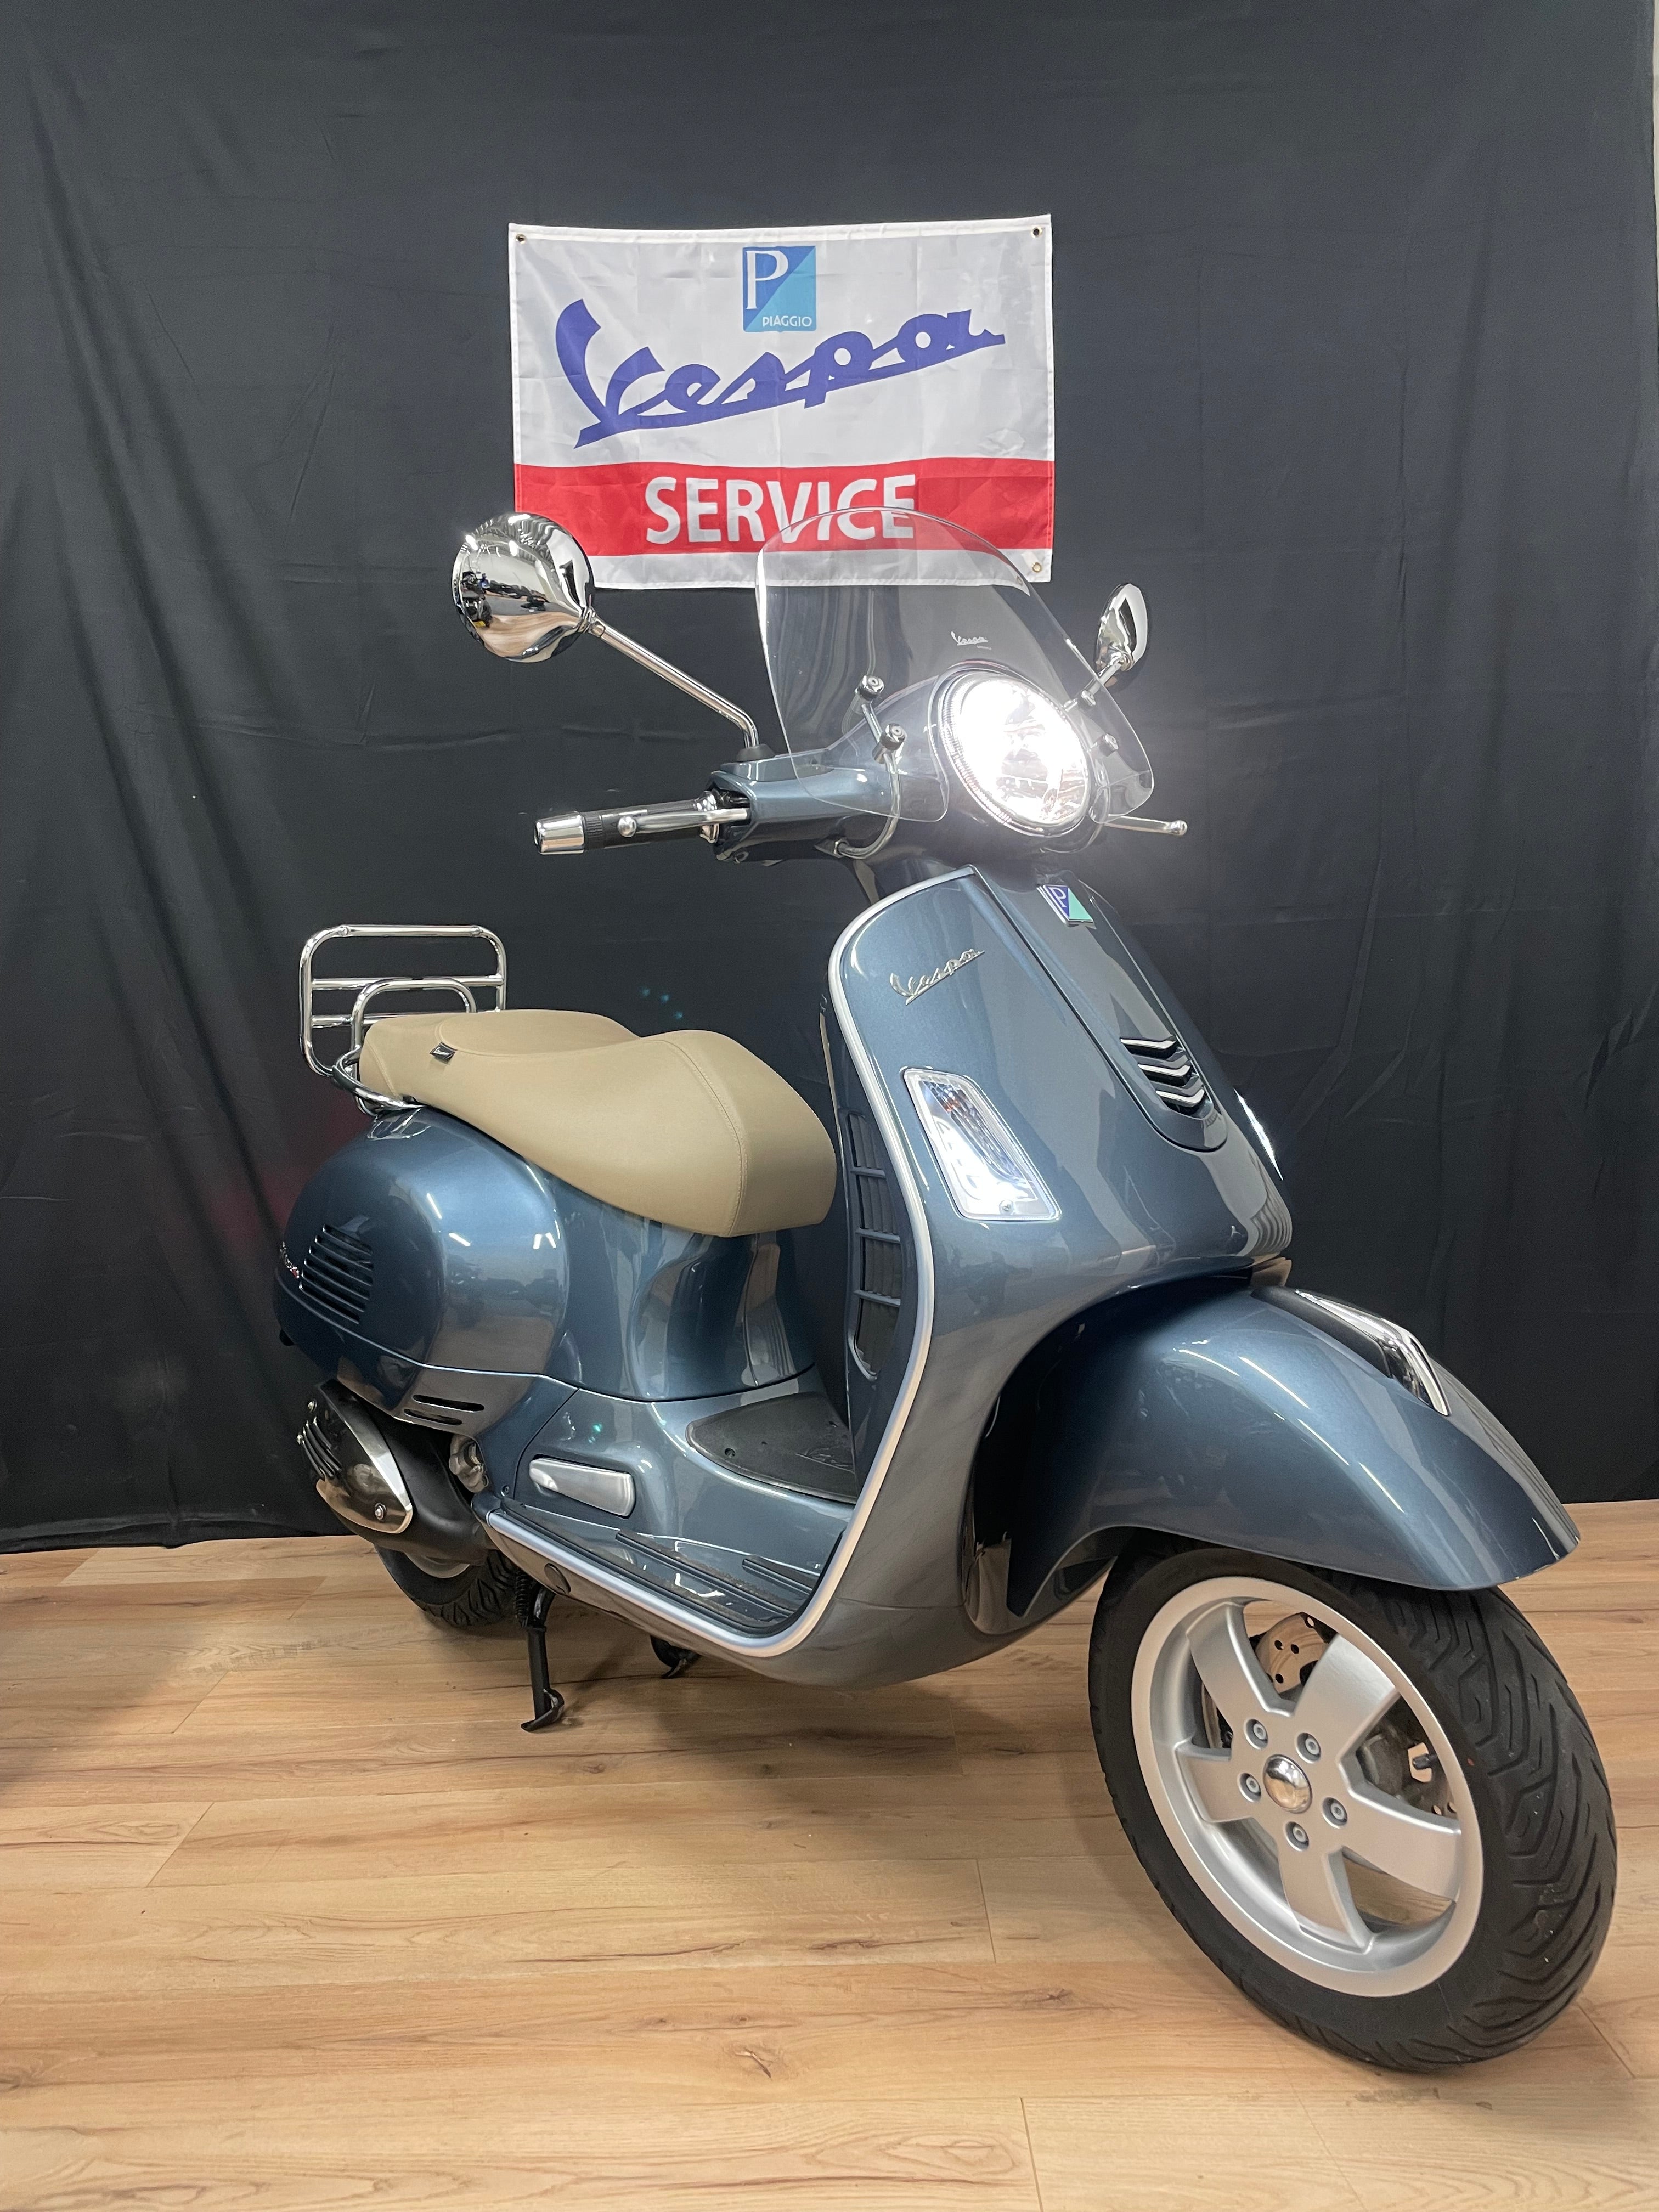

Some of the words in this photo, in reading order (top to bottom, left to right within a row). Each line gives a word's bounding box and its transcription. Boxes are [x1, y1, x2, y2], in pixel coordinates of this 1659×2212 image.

[746, 250, 789, 309] P
[762, 315, 812, 327] PIAGGIO
[555, 299, 1006, 449] Vespa
[644, 473, 917, 544] SERVICE
[951, 630, 989, 646] Vespa
[1047, 887, 1067, 908] P
[889, 949, 985, 1006] Vespa
